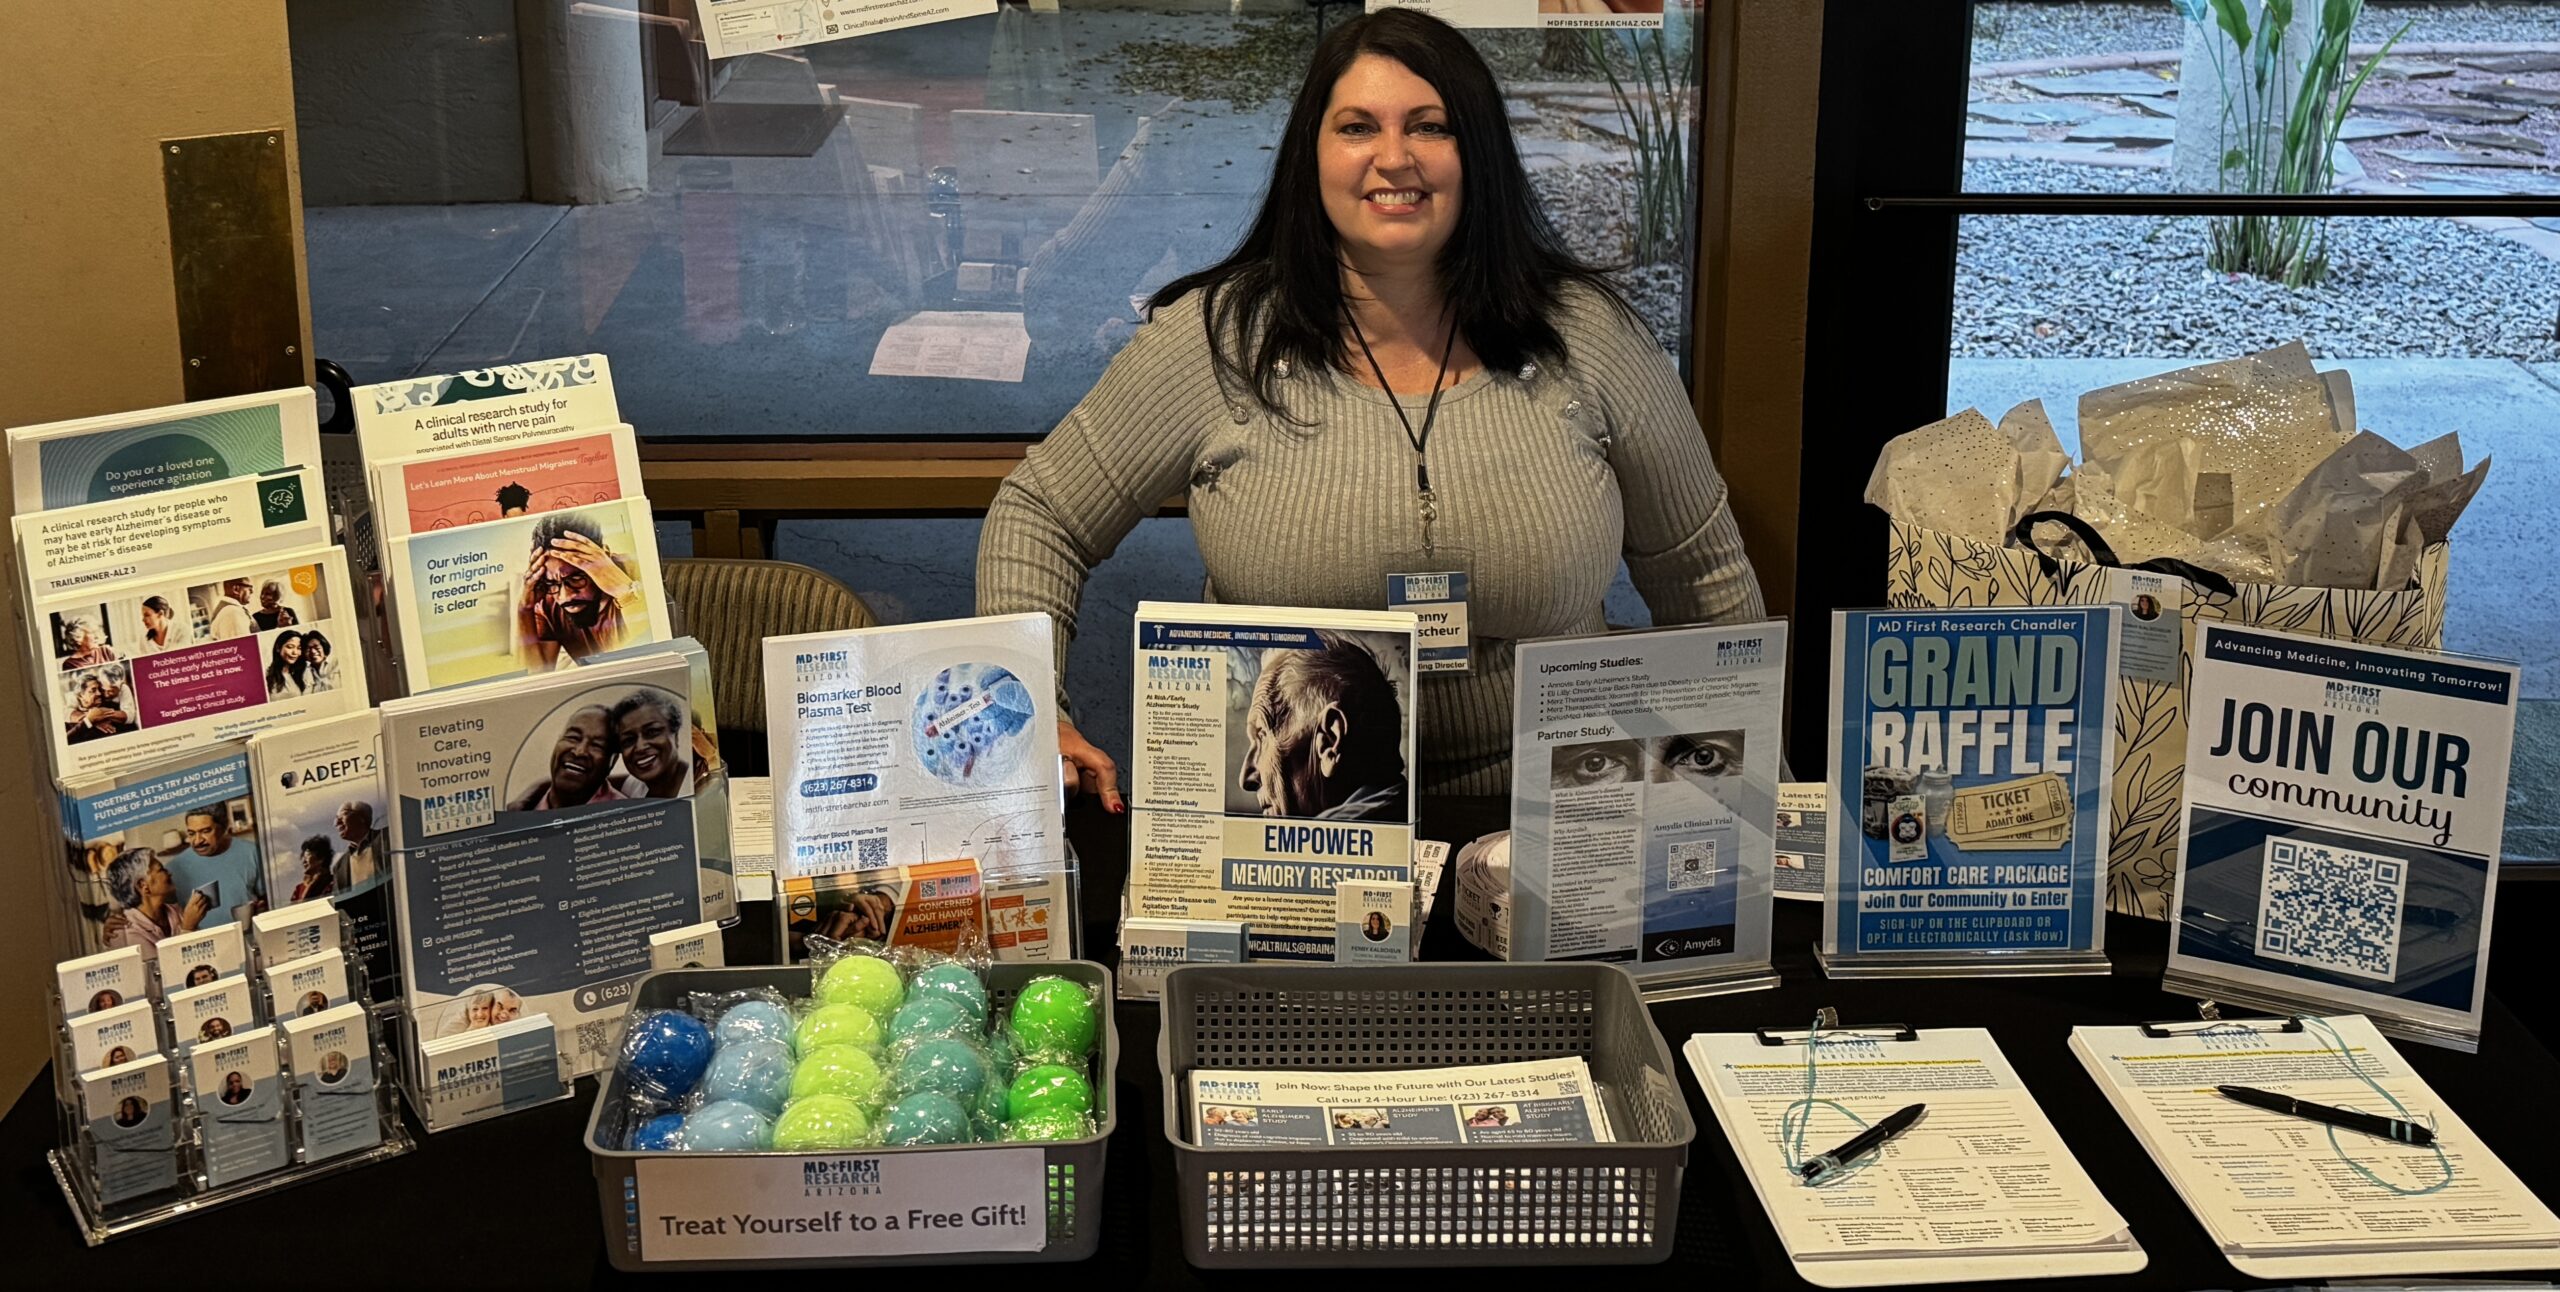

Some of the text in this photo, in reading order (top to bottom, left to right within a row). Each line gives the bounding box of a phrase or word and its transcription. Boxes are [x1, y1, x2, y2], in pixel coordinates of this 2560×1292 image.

[414, 399, 568, 431] A clinical research study for
[432, 415, 556, 442] adults with nerve pain
[109, 470, 212, 494] experience agitation
[410, 459, 578, 491] Let's Learn More About Menstrual Migraines
[42, 495, 228, 534] A clinical research study for people who
[43, 507, 223, 545] may have early Alzheimer's disease or
[45, 516, 232, 556] may be at risk for developing symptoms
[47, 542, 153, 568] of Alzheimer's disease
[427, 551, 488, 570] Our vision
[50, 566, 136, 588] TRAILRUNNER-ALZ 3
[429, 563, 504, 586] for migraine
[432, 581, 486, 600] research
[434, 598, 478, 615] is clear
[1418, 613, 1448, 623] enny
[1877, 618, 2077, 633] MD First Research Chandler
[1148, 668, 1210, 681] RESEARCH
[1540, 656, 1643, 676] Upcoming Studies:
[1868, 634, 2079, 708] GRAND
[2214, 639, 2502, 692] Advancing Medicine, Innovating Tomorrow!
[153, 680, 170, 688] The
[170, 676, 190, 685] time
[201, 670, 215, 679] act
[223, 666, 242, 675] now.
[1148, 681, 1211, 691] ARIZONA
[797, 682, 902, 705] Biomarker Blood
[797, 702, 872, 719] Plasma Test
[419, 718, 484, 738] Elevating
[1537, 725, 1615, 741] Partner Study:
[433, 738, 471, 752] Care,
[1871, 709, 2075, 774] RAFFLE
[2210, 698, 2471, 799] JOIN OUR
[302, 754, 376, 785] ADEPT-2
[416, 751, 492, 773] Innovating
[92, 762, 237, 810] TOGETHER, LET'S TRY AND CHANGE
[420, 768, 490, 789] Tomorrow
[804, 777, 873, 794] (623) 267-8314
[94, 774, 234, 822] FUTURE OF ALZHEIMER'S DISEASE
[1981, 788, 2031, 809] TICKET
[2228, 773, 2452, 846] community
[1653, 816, 1733, 832] Amydis Clinical Trial
[1985, 813, 2035, 829] ADMIT ONE
[1265, 825, 1373, 857] EMPOWER
[1232, 863, 1305, 888] MEMORY
[1864, 865, 2068, 886] COMFORT CARE PACKAGE
[919, 898, 973, 911] CONCERNED
[1865, 891, 2068, 910] Join Our Community to Enter
[907, 908, 973, 923] ABOUT HAVING
[1879, 916, 2051, 930] SIGN-UP ON THE CLIPBOARD OR
[1684, 937, 1722, 951] Amydis
[1867, 930, 2063, 944] OPT-IN ELECTRONICALLY (Ask How)
[1275, 1082, 1298, 1091] Join
[1301, 1083, 1331, 1091] Now:
[1333, 1084, 1371, 1093] Shape
[1373, 1083, 1393, 1091] the
[1436, 1080, 1462, 1089] with
[1464, 1079, 1487, 1087] Our
[1489, 1076, 1526, 1085] Latest
[1528, 1070, 1575, 1083] Studies!
[1316, 1096, 1339, 1104] Call
[1449, 1093, 1481, 1101] (623)
[1483, 1088, 1540, 1099] 267-8314
[804, 1171, 880, 1186] RESEARCH
[804, 1185, 882, 1197] ARIZONA
[659, 1204, 1026, 1236] Treat Yourself to a Free Gift!
